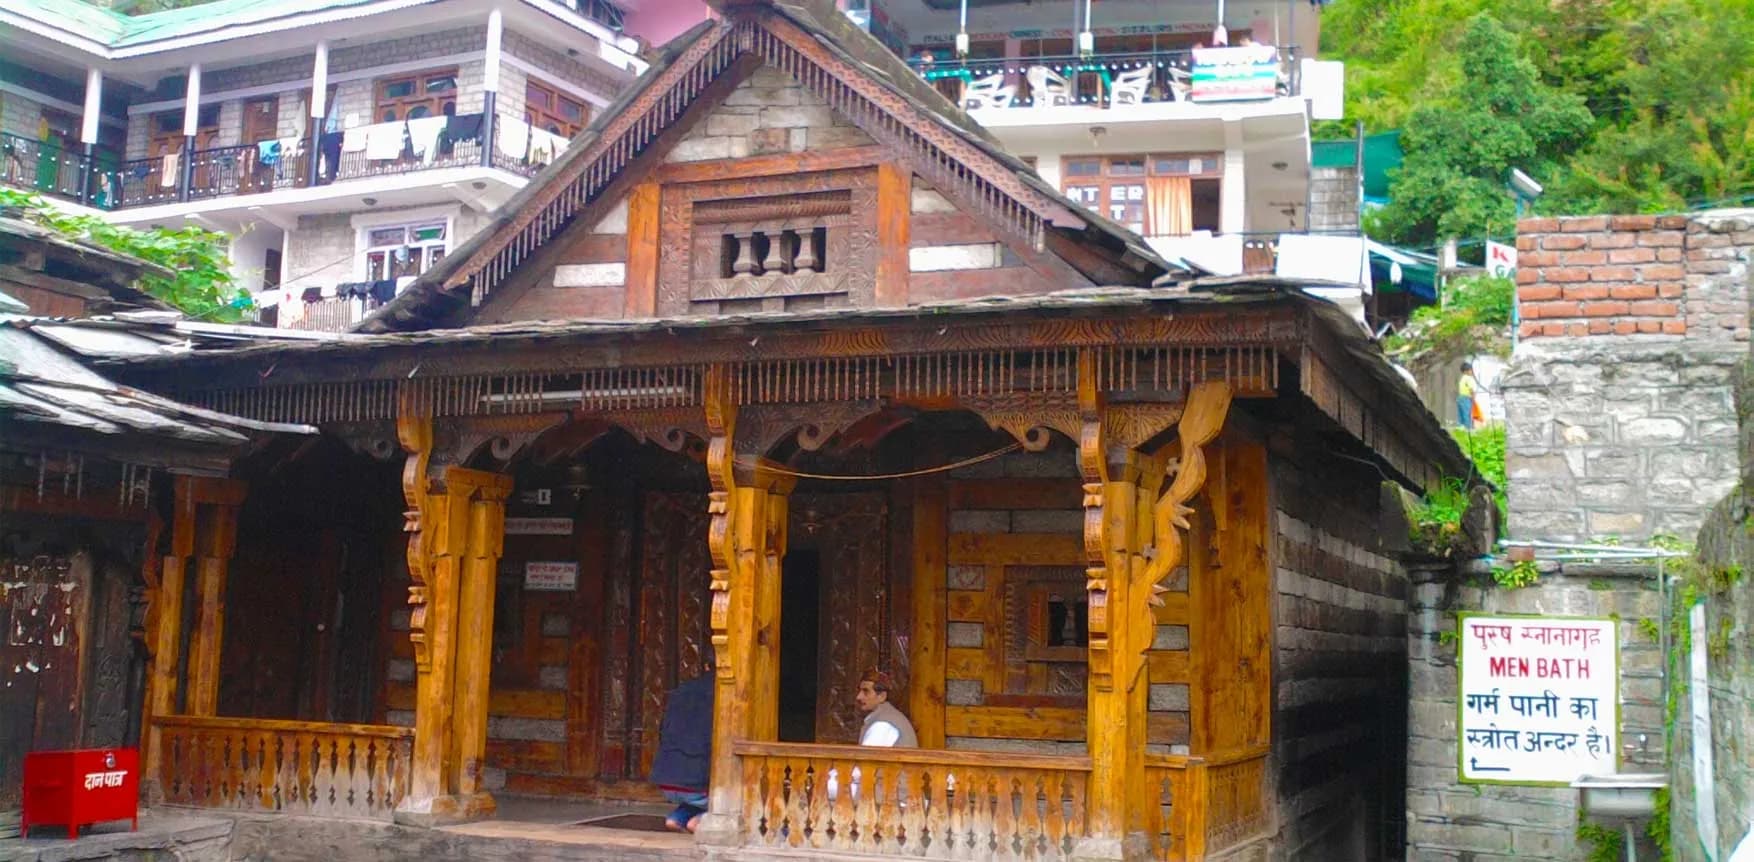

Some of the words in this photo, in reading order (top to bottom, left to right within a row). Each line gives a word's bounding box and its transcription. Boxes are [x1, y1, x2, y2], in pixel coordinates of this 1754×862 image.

[1490, 656, 1530, 678] MEN
[1536, 657, 1590, 680] BATH
[1466, 687, 1500, 715] गर्म
[1508, 689, 1561, 718] पानी
[1569, 697, 1599, 720] का
[1524, 730, 1580, 753] अन्दर
[84, 772, 105, 791] दान
[104, 770, 129, 788] पात्र
